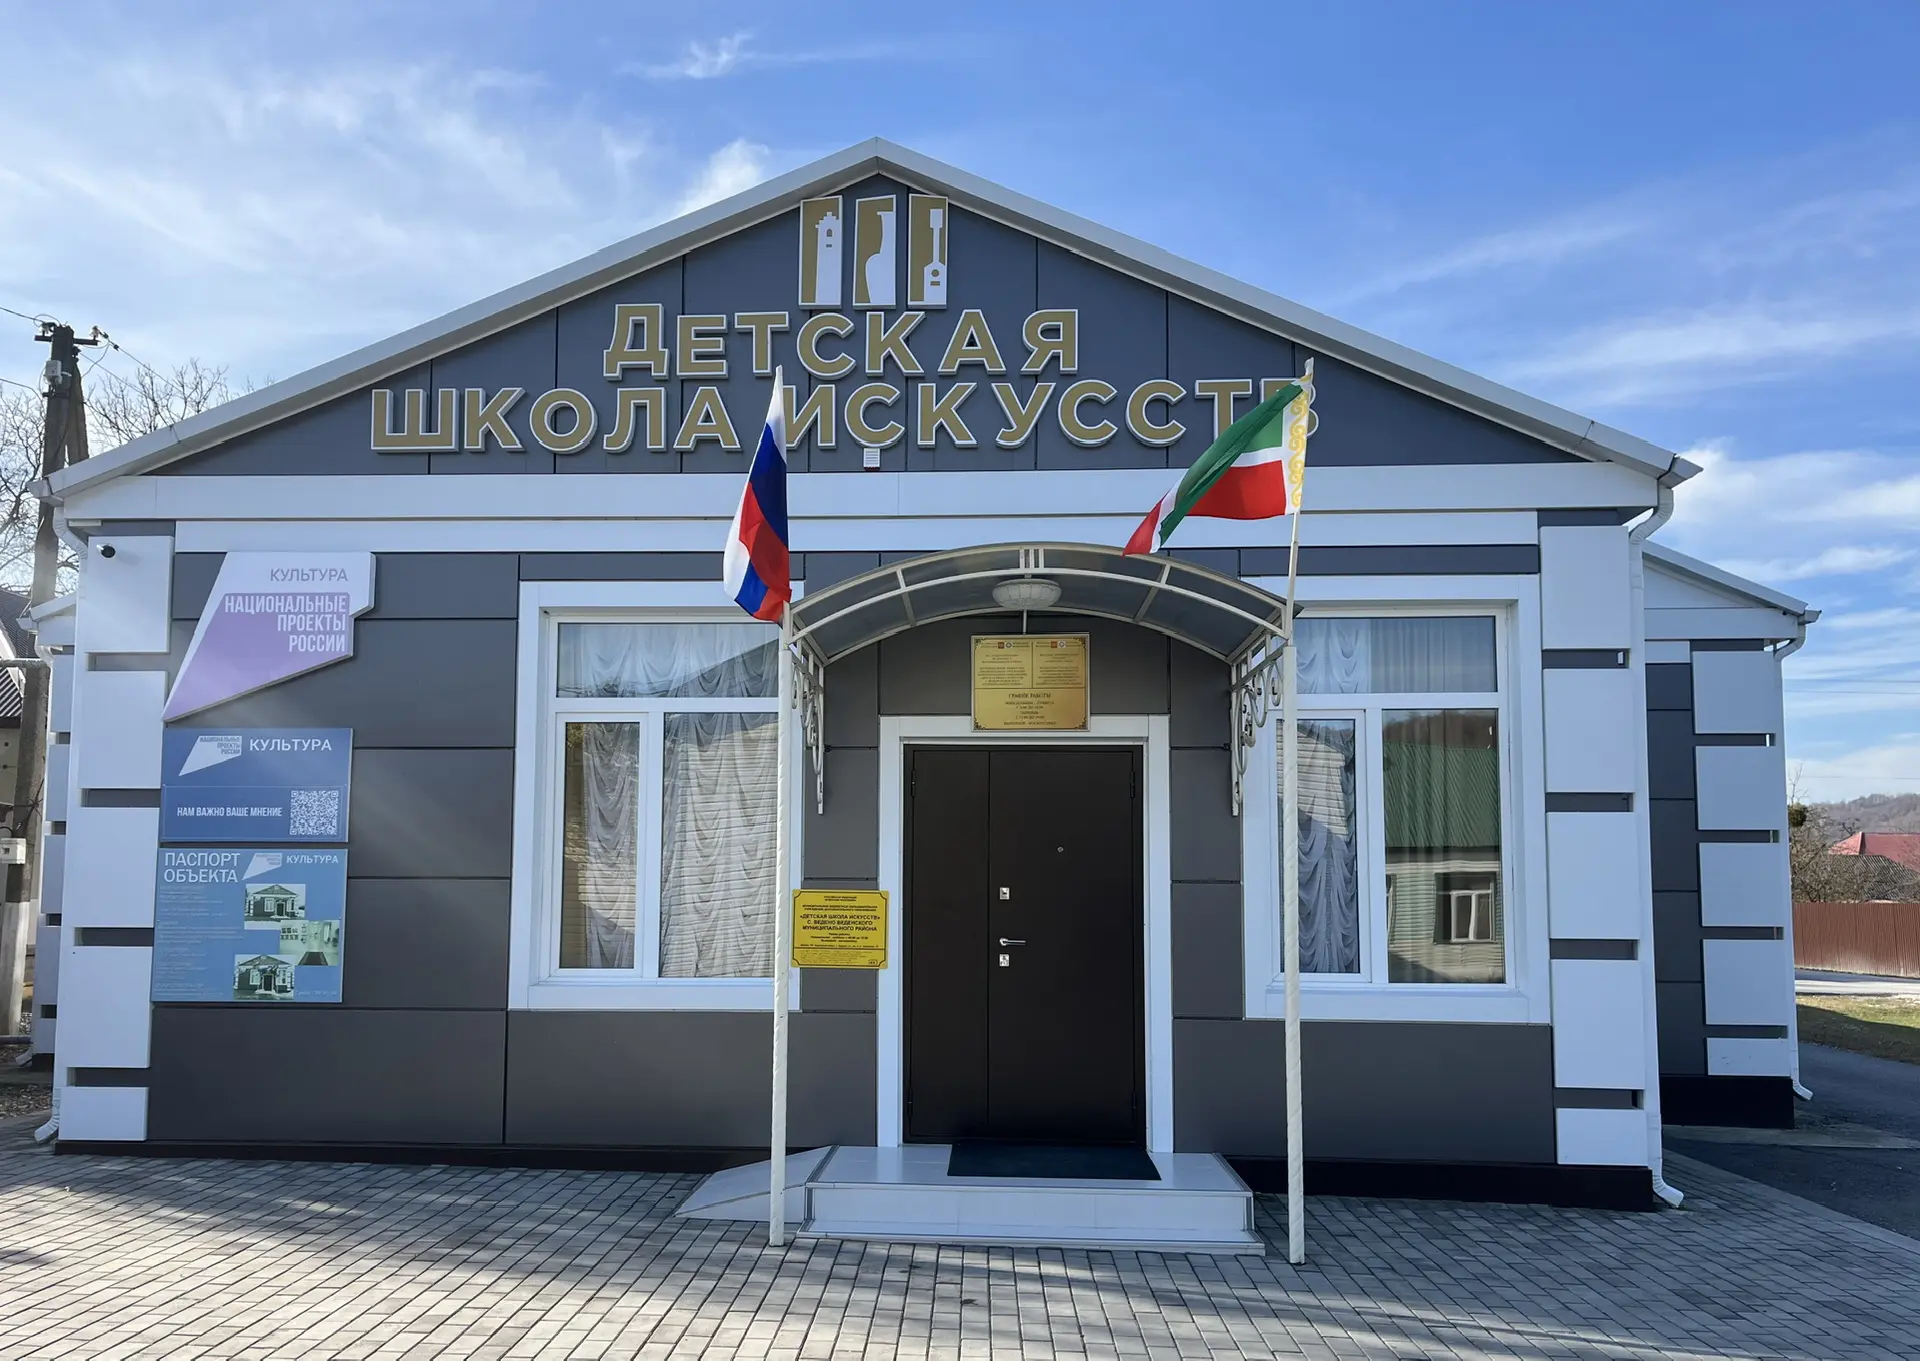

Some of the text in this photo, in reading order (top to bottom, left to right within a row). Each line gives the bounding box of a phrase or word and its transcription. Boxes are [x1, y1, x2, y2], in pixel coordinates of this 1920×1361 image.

[603, 303, 1079, 381] ДЕТСКАЯ
[371, 386, 742, 454] ШКОЛА
[269, 567, 348, 582] КУЛЬТУРА
[224, 595, 347, 614] НАЦИОНАЛЬНЫЕ
[277, 614, 346, 631] ПРОЕКТЫ
[288, 634, 345, 652] РОССИИ
[249, 738, 332, 751] КУЛЬТУРА
[177, 806, 283, 817] НАМ ВАЖНО ВАШЕ МНЕНИЕ
[164, 852, 241, 867] ПАСПОРТ
[286, 854, 339, 865] КУЛЬТУРА
[163, 868, 239, 883] ОБЪЕКТА
